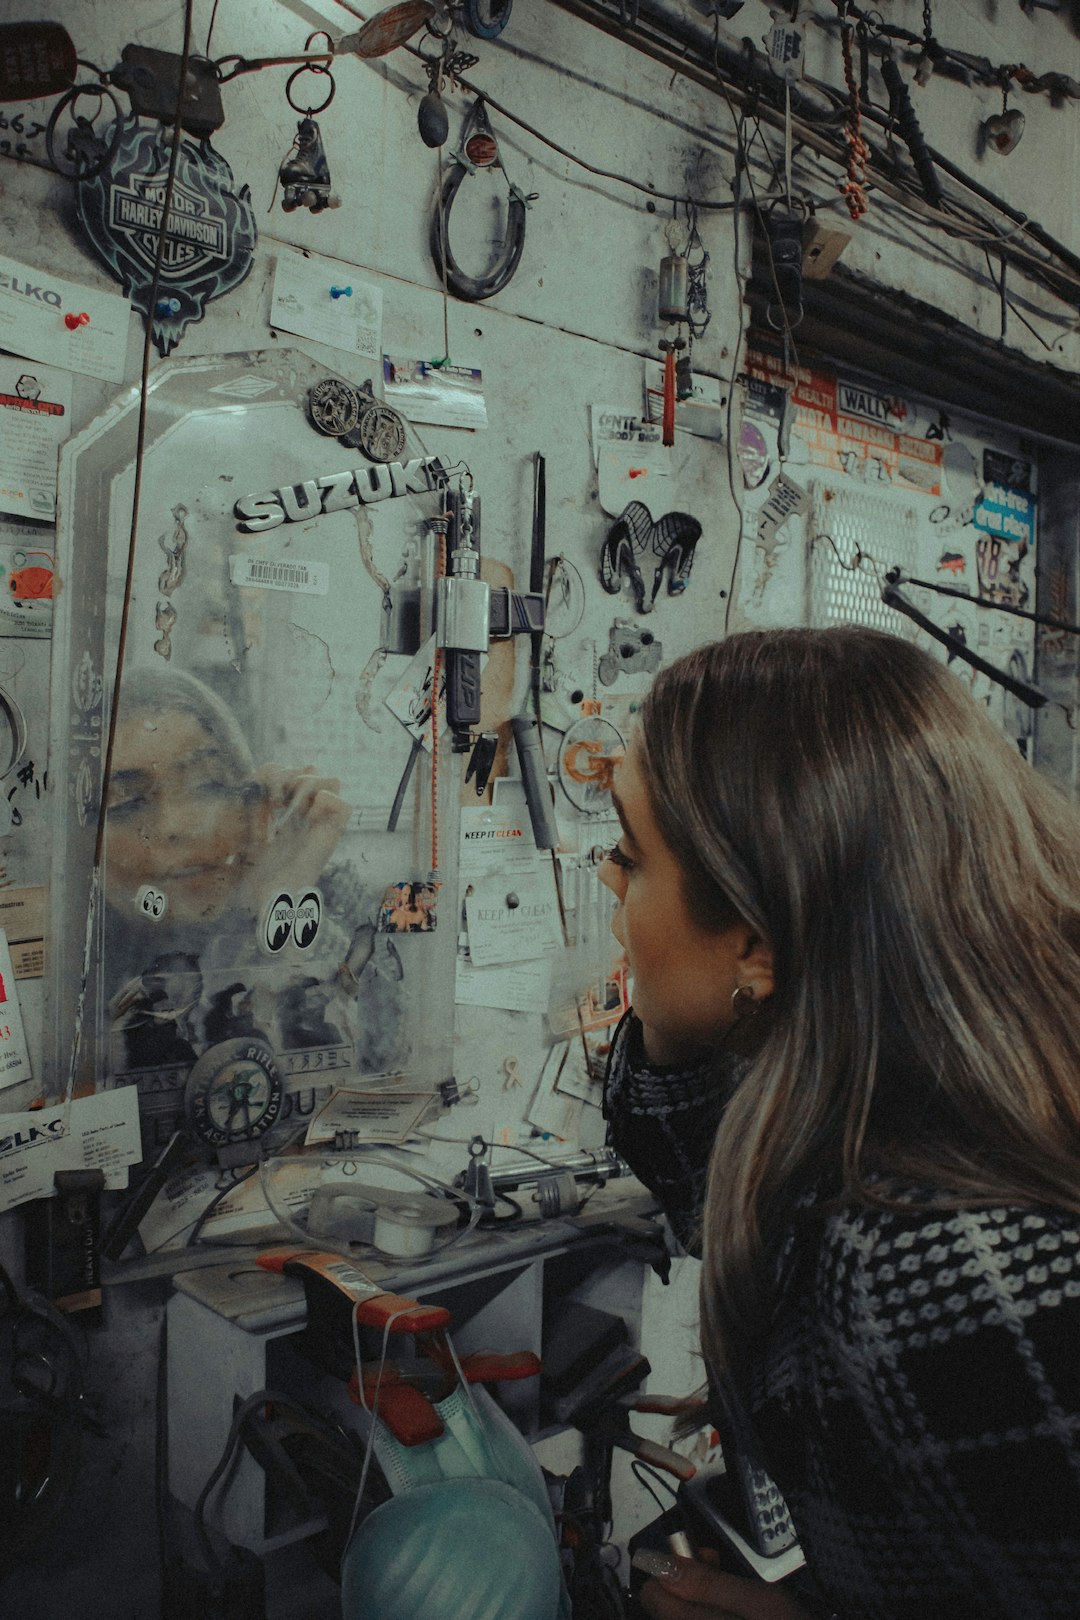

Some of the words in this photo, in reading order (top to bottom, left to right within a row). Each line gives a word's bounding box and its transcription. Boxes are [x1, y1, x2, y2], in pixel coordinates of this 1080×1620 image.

[234, 456, 447, 533] SUZUKI
[465, 831, 486, 840] KEEP
[486, 830, 496, 839] IT
[496, 829, 522, 838] CLEAN
[275, 908, 314, 921] MOON
[477, 909, 504, 921] KEEP
[520, 903, 552, 917] CLEAN
[247, 1047, 276, 1077] RIFLE
